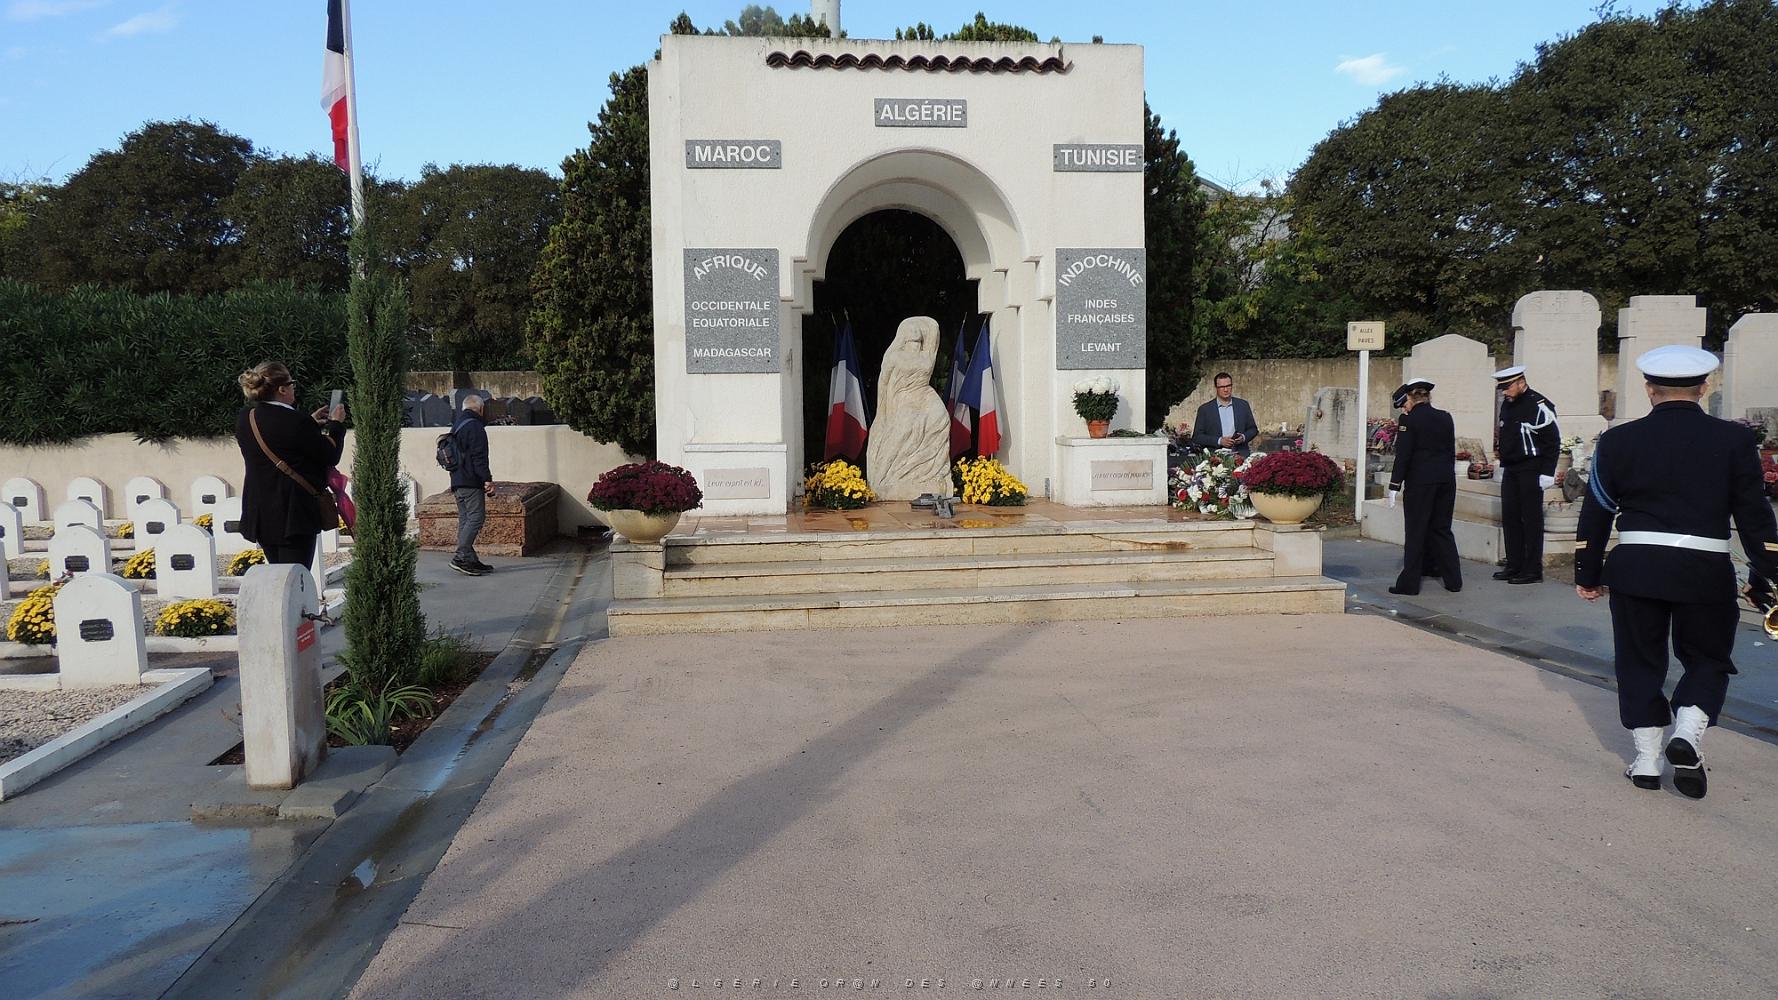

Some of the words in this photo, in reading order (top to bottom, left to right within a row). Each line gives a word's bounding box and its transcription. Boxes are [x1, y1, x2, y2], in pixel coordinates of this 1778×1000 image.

[880, 100, 962, 121] ALGÉRIE
[695, 145, 771, 162] MAROC
[1060, 149, 1137, 166] TUNISIE
[693, 254, 768, 281] AFRIQUE
[1058, 254, 1144, 287] INDOCHINE
[691, 300, 771, 311] OCCIDENTALE
[1085, 299, 1118, 309] INDES
[693, 317, 770, 328] EQUATORIALE
[1068, 313, 1135, 325] FRANÇAISES
[693, 347, 772, 358] MADAGASCAR
[1081, 342, 1122, 352] LEVANT
